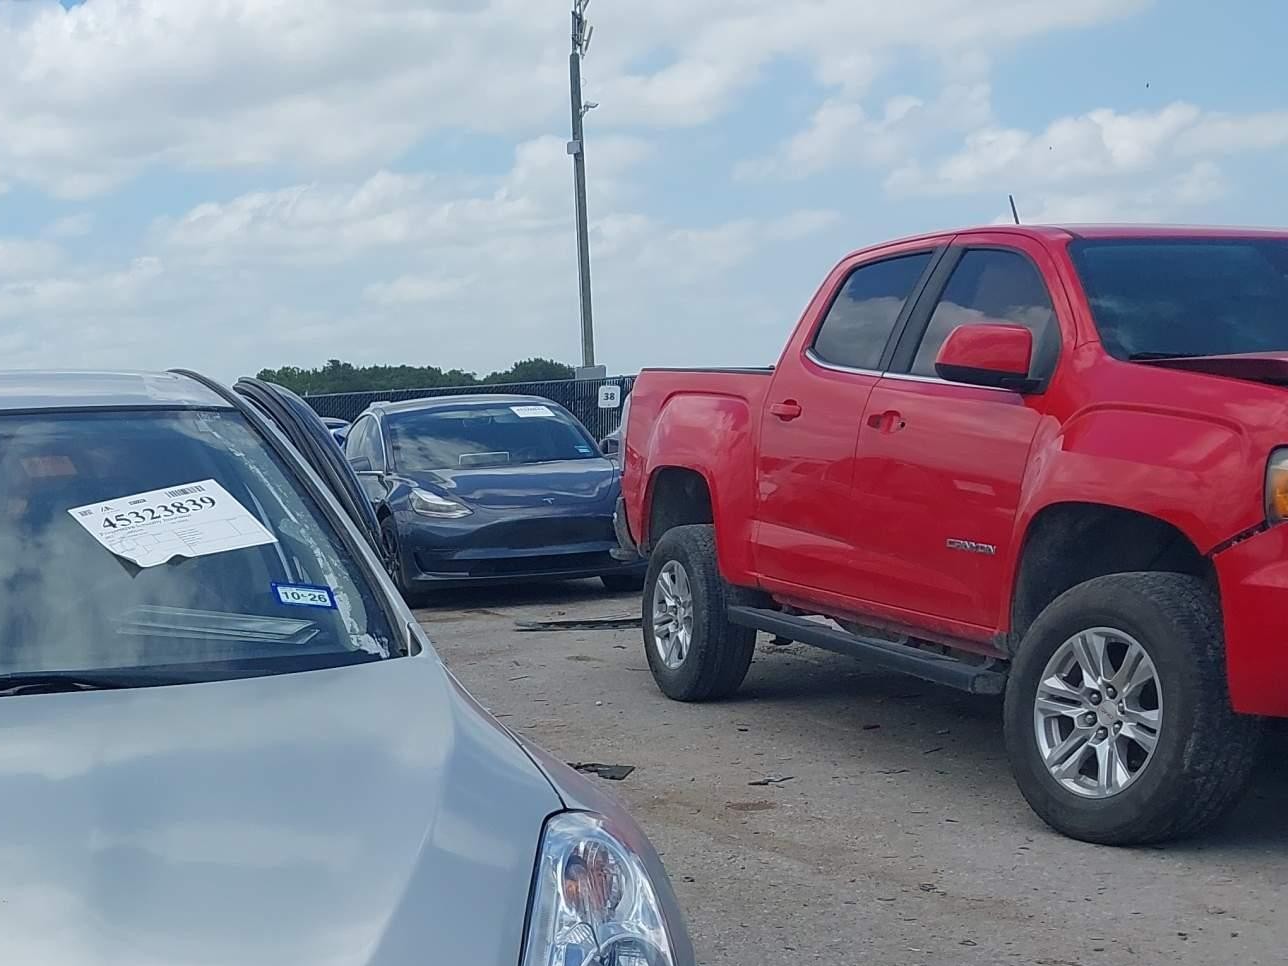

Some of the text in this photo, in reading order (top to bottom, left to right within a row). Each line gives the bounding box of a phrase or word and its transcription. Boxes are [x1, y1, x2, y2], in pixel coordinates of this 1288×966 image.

[603, 392, 616, 401] 38
[102, 496, 216, 530] 45323839
[946, 538, 996, 554] CANYON
